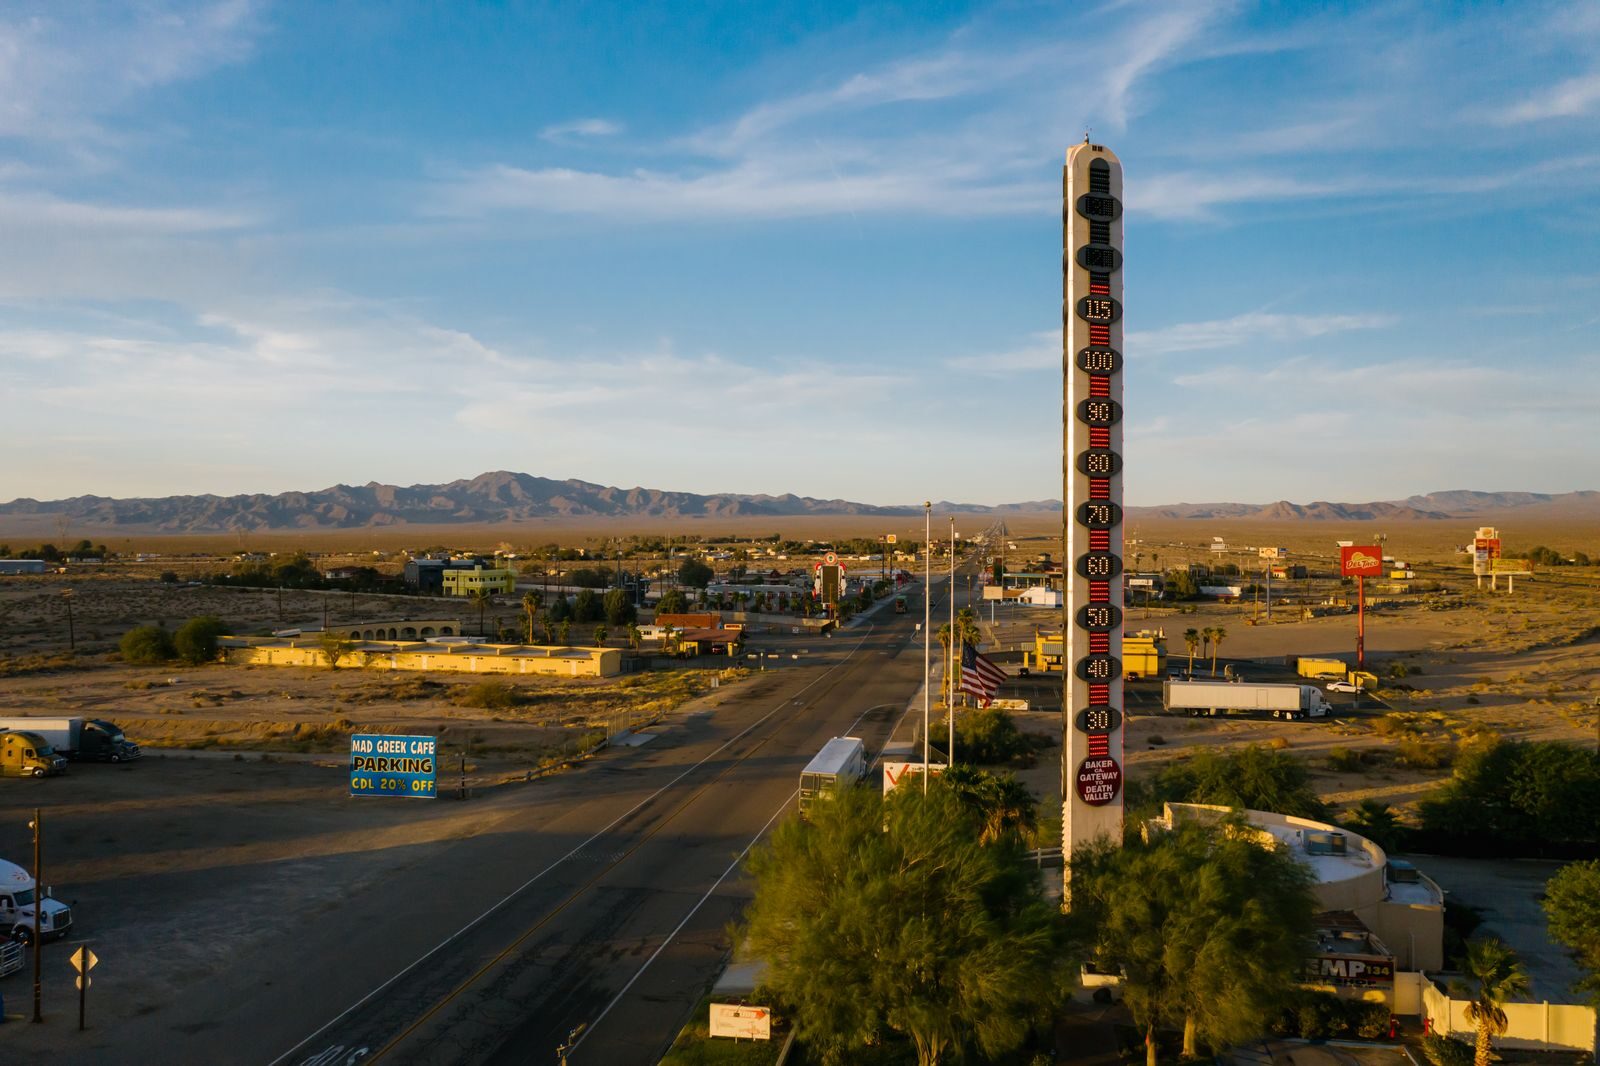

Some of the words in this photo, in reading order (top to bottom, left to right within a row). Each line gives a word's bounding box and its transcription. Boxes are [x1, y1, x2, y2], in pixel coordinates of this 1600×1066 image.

[1087, 301, 1110, 319] 115
[1085, 352, 1111, 370] 100
[1089, 403, 1108, 420] 90
[1089, 455, 1108, 471] 80
[1089, 506, 1108, 523] 70
[1089, 557, 1108, 574] 60
[1089, 609, 1107, 625] 50
[1088, 660, 1107, 677] 40
[1088, 711, 1107, 728] 30
[352, 739, 373, 753] MAD
[377, 739, 406, 754] GREEK
[410, 740, 434, 755] CAFE
[353, 755, 433, 774] PARKING
[1085, 760, 1113, 769] BAKER
[351, 777, 375, 790] CDL
[380, 777, 406, 790] 20%
[412, 779, 434, 791] OFF
[1079, 772, 1118, 782] GATEWAY
[1084, 792, 1114, 802] VALLEY
[1085, 784, 1113, 794] DEATH
